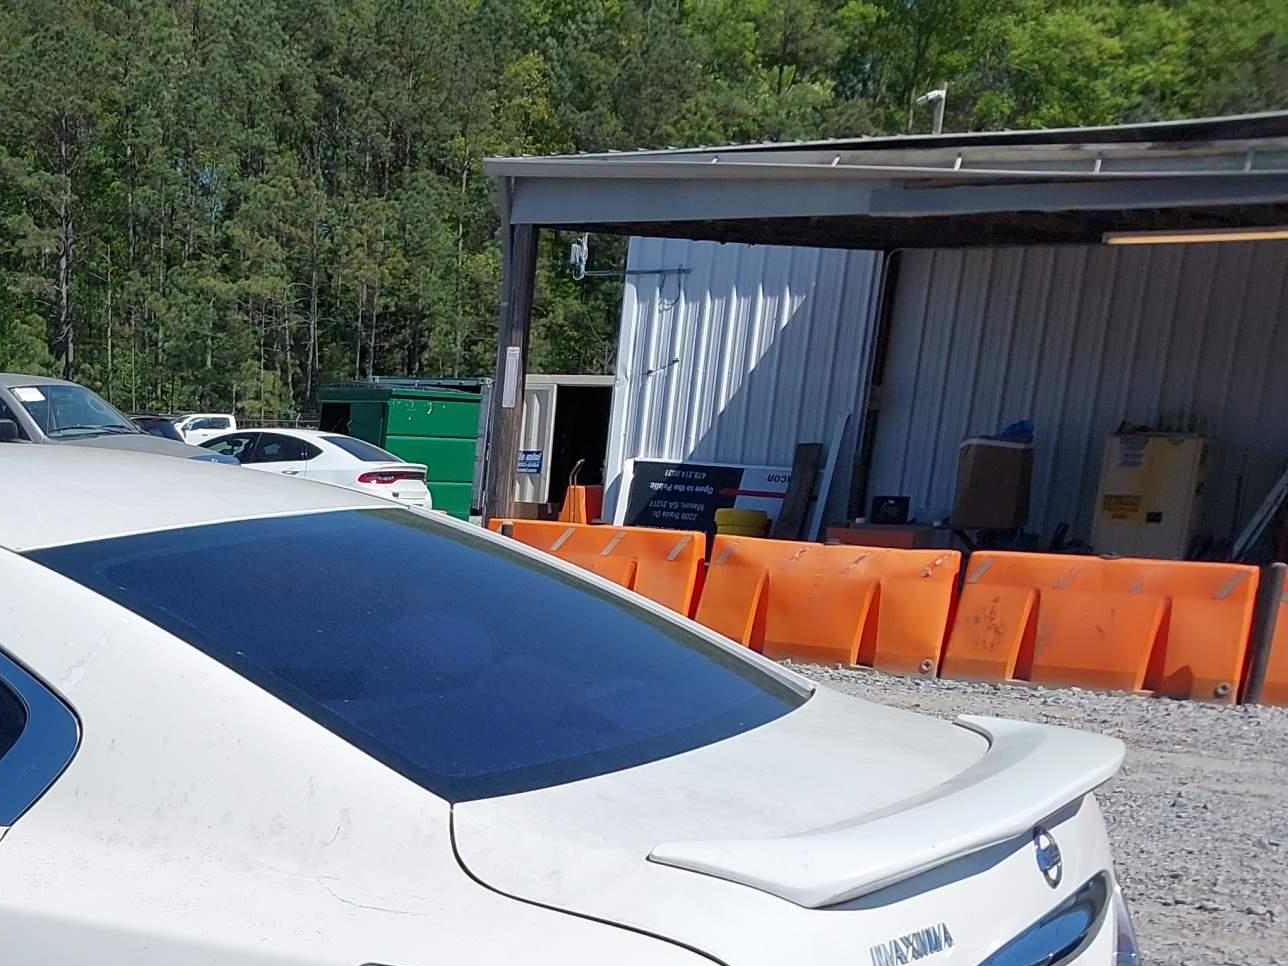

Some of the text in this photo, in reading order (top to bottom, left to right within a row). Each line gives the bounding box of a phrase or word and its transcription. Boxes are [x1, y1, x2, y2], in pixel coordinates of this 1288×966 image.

[649, 482, 673, 491] Public
[674, 484, 685, 492] the
[695, 484, 714, 495] Open
